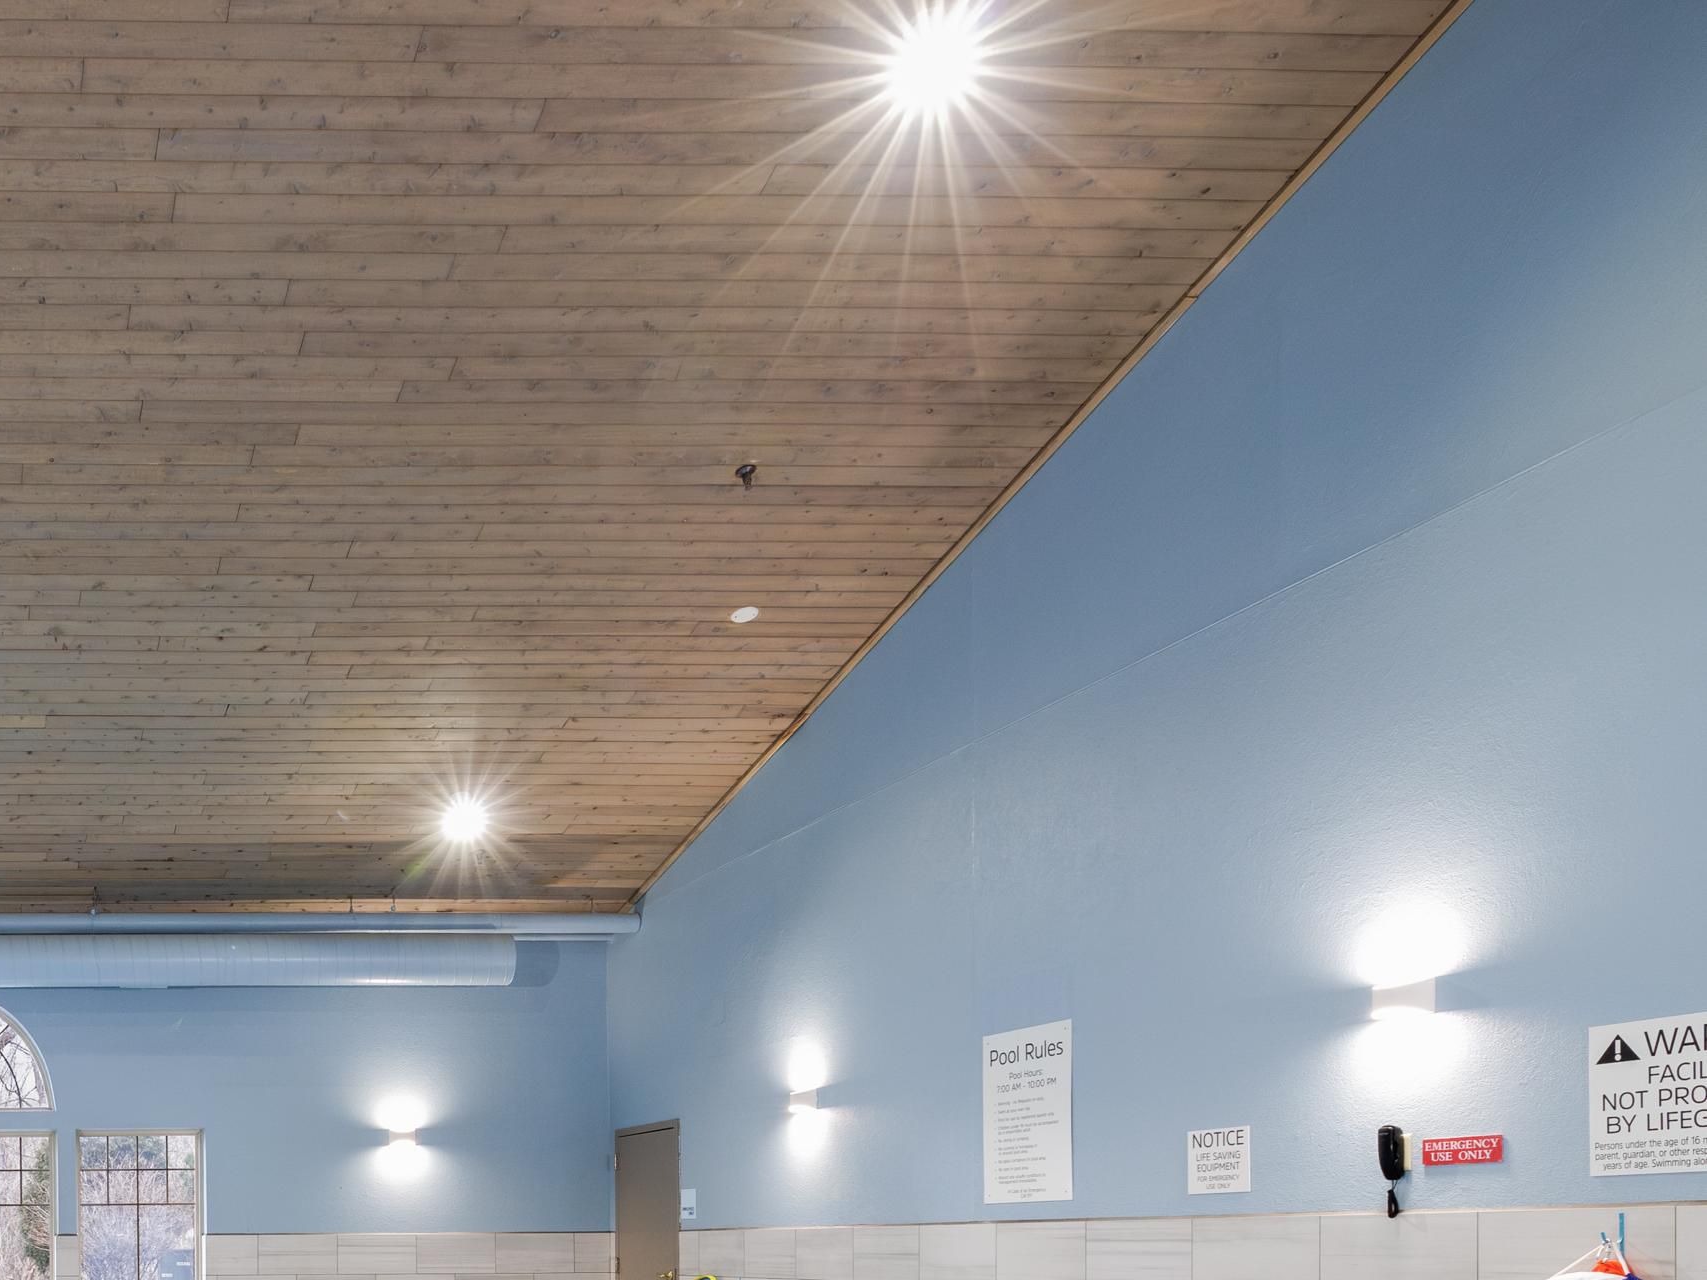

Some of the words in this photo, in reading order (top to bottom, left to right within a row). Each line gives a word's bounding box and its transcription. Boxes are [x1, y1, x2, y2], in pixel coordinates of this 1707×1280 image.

[1644, 1023, 1707, 1057] WA
[990, 1045, 1019, 1067] Pool
[1025, 1040, 1064, 1061] Rules
[1009, 1072, 1022, 1080] Pool
[1011, 1082, 1022, 1091] AM
[1027, 1079, 1045, 1089] 10:00
[1046, 1077, 1057, 1085] PM
[1602, 1090, 1649, 1111] NOT
[1607, 1114, 1636, 1134] BY
[1192, 1129, 1245, 1149] NOTICE
[1424, 1138, 1499, 1152] EMERGENCY
[1595, 1142, 1623, 1151] Persons
[1625, 1140, 1647, 1149] under
[1649, 1139, 1662, 1147] the
[1664, 1139, 1678, 1148] age
[1680, 1136, 1689, 1146] of
[1691, 1135, 1701, 1145] 16
[1196, 1152, 1211, 1162] LIFE
[1213, 1150, 1241, 1161] SAVING
[1430, 1152, 1453, 1162] USE
[1458, 1149, 1492, 1160] ONLY
[1669, 1148, 1690, 1157] other
[1197, 1161, 1240, 1173] EQUIPMENT
[1603, 1162, 1622, 1171] years
[1624, 1160, 1632, 1169] of
[1651, 1158, 1691, 1168] Swimming
